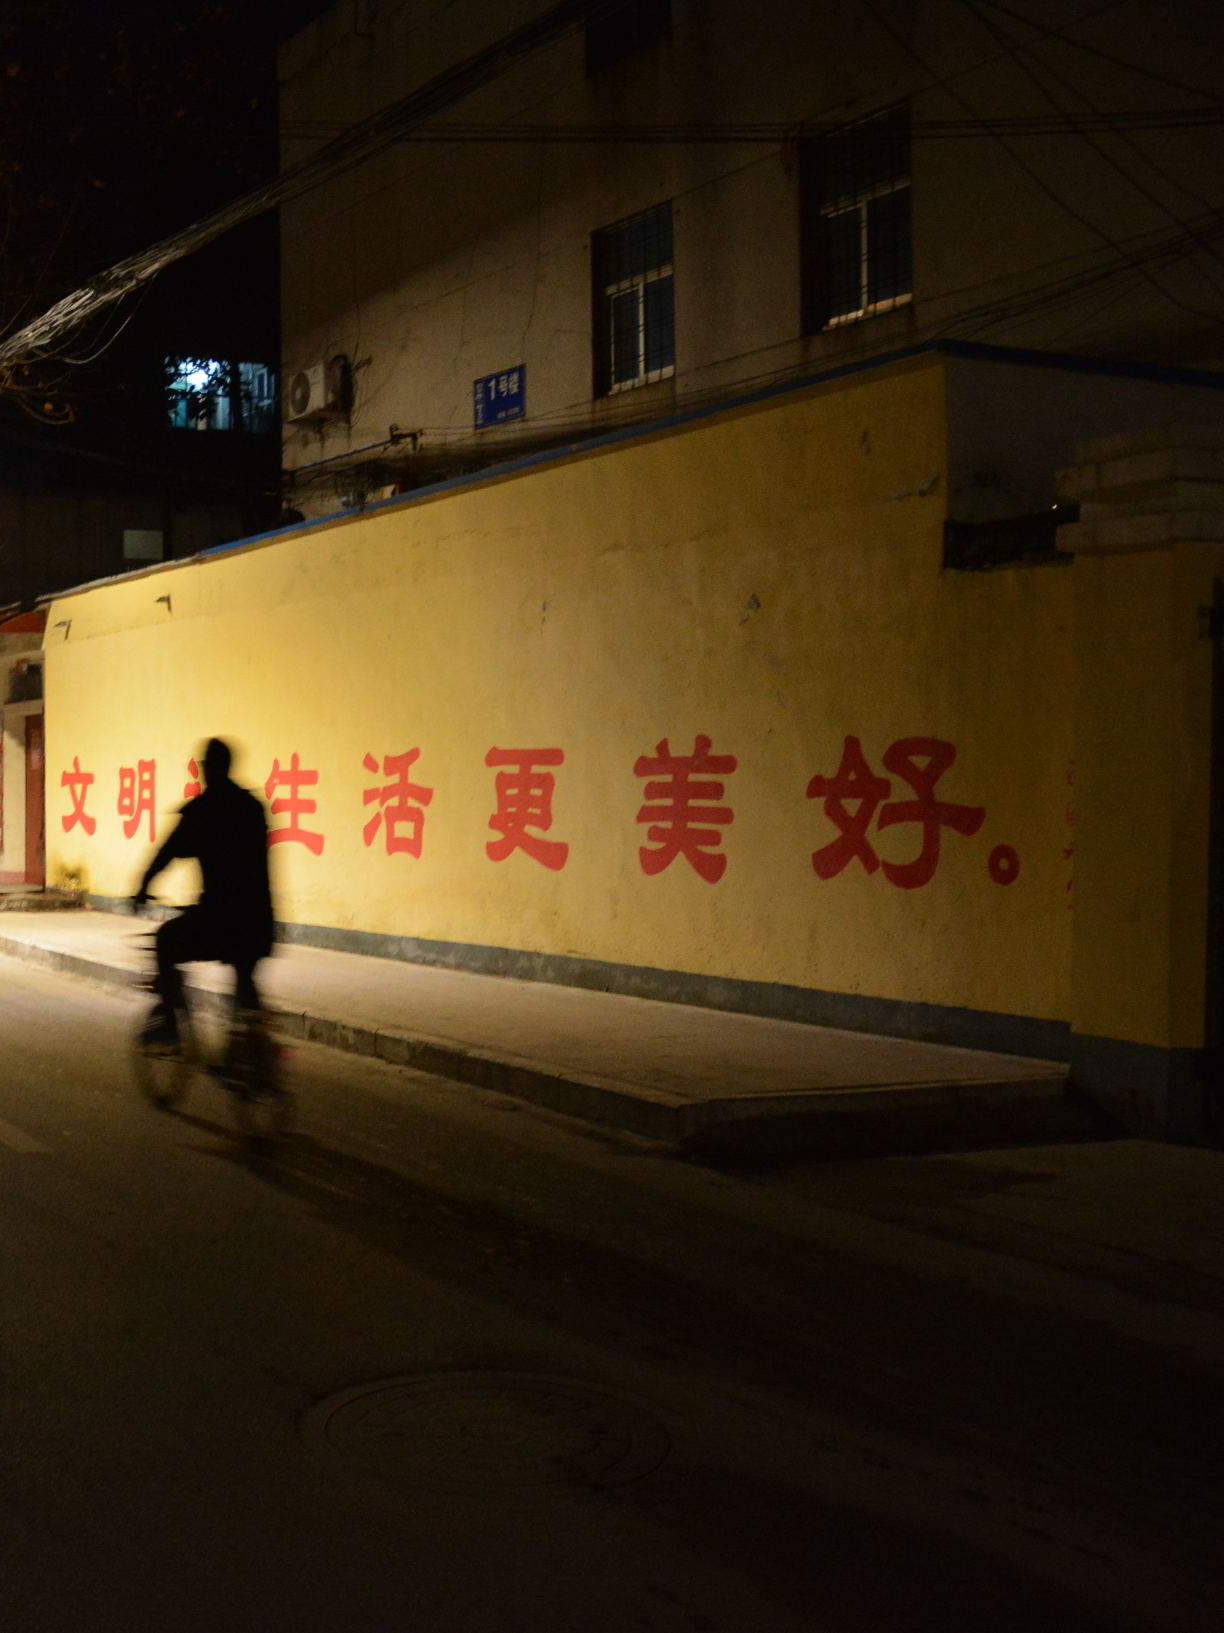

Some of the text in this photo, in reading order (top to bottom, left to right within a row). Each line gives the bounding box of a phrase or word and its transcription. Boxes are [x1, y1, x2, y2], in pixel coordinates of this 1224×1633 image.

[61, 734, 1019, 888] 文明生活更美好。
